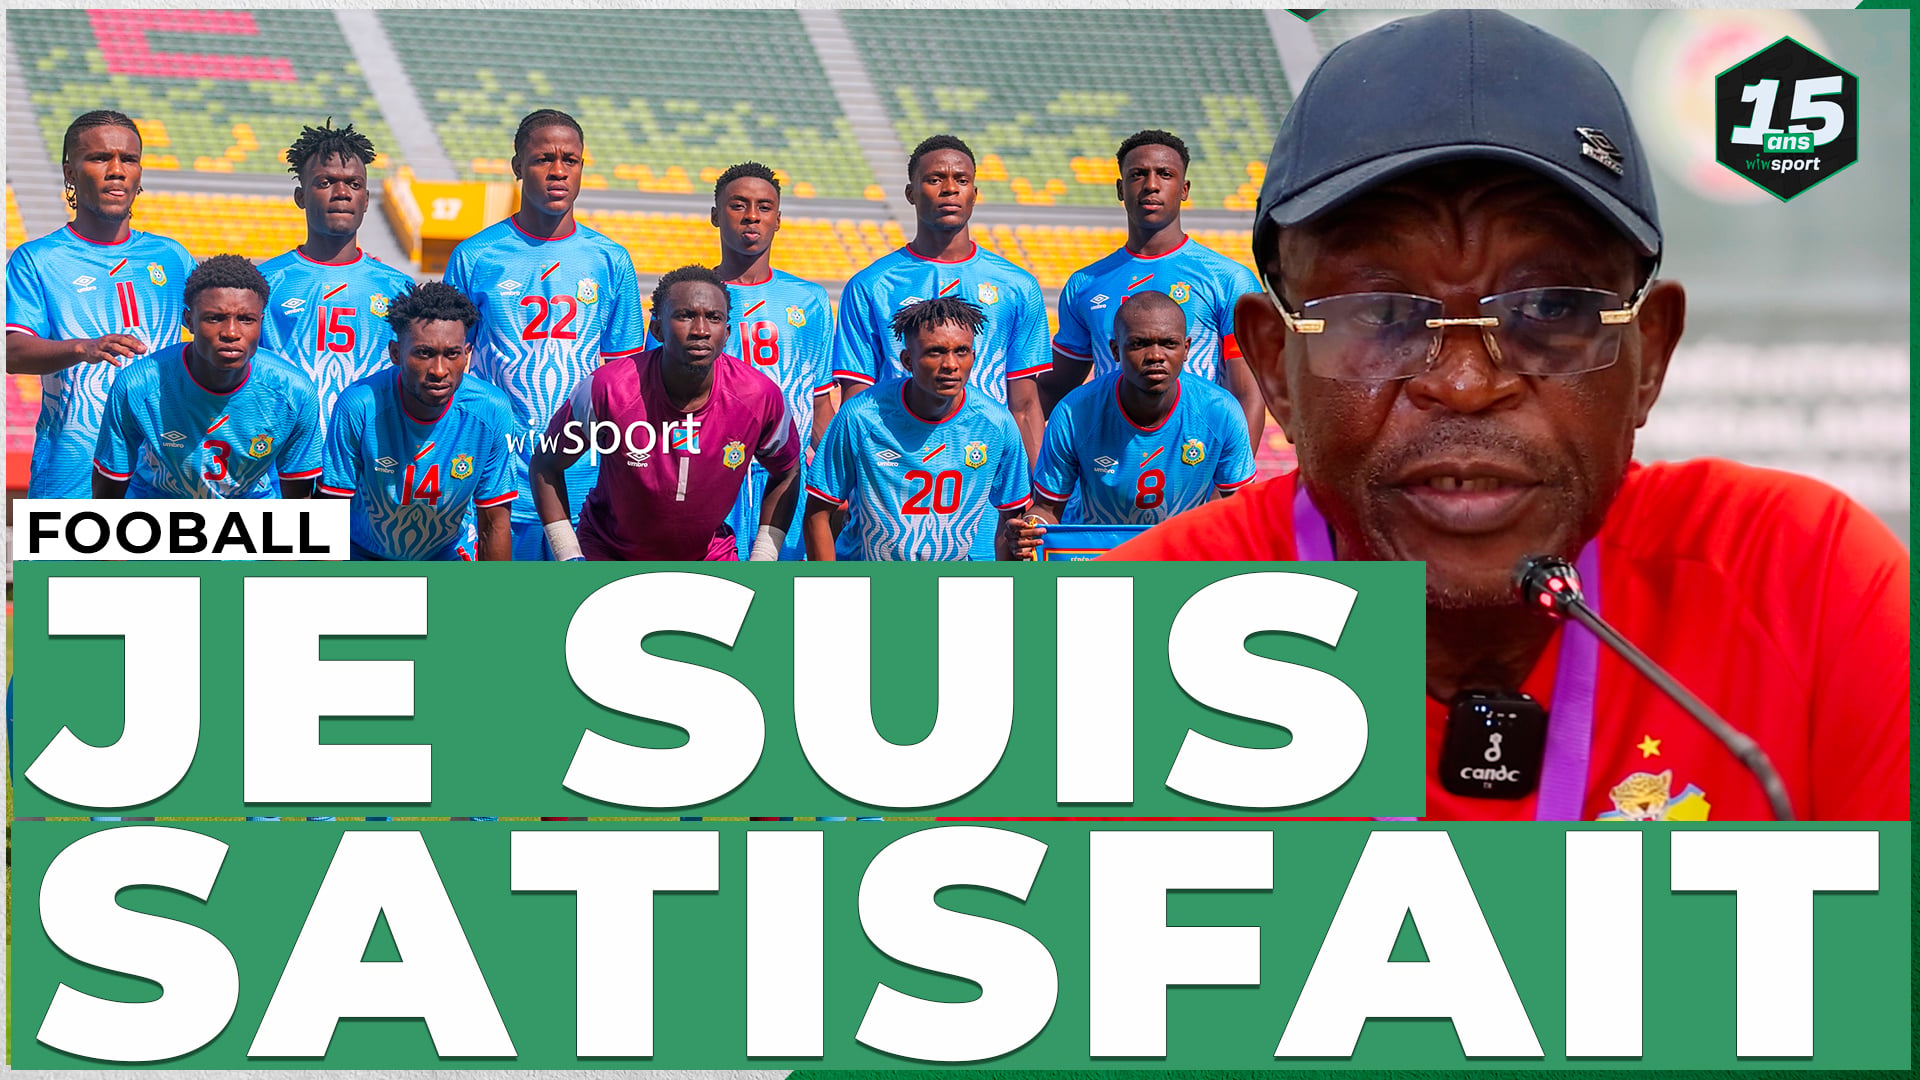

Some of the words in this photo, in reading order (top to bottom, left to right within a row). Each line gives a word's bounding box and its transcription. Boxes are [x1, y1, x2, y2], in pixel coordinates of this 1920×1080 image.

[115, 281, 140, 328] 11
[520, 294, 577, 341] 22
[316, 305, 356, 353] 15
[739, 321, 779, 366] 18
[203, 440, 231, 480] 3
[627, 460, 649, 468] umbro
[675, 456, 690, 501] 1
[401, 464, 442, 506] 14
[901, 469, 963, 515] 20
[1135, 468, 1166, 510] 8
